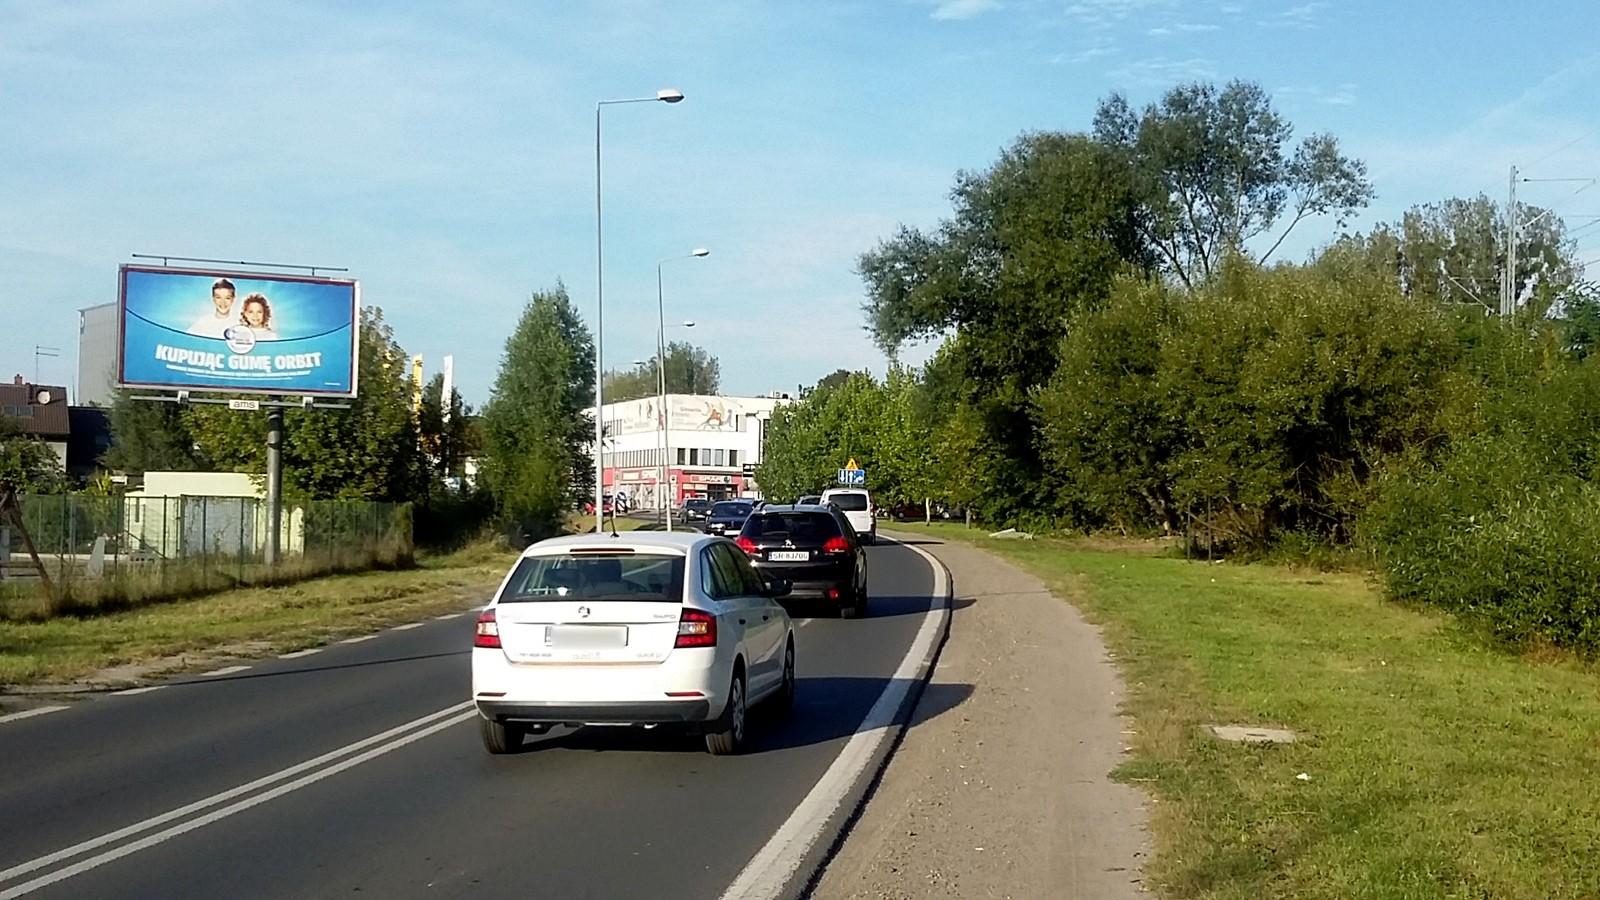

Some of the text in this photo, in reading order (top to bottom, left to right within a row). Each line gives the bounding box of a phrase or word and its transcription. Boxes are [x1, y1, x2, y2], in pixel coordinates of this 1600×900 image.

[155, 344, 224, 371] KUPUJĄC
[228, 355, 272, 373] GUMĘ
[274, 352, 322, 370] ORBIT
[233, 400, 256, 409] ams
